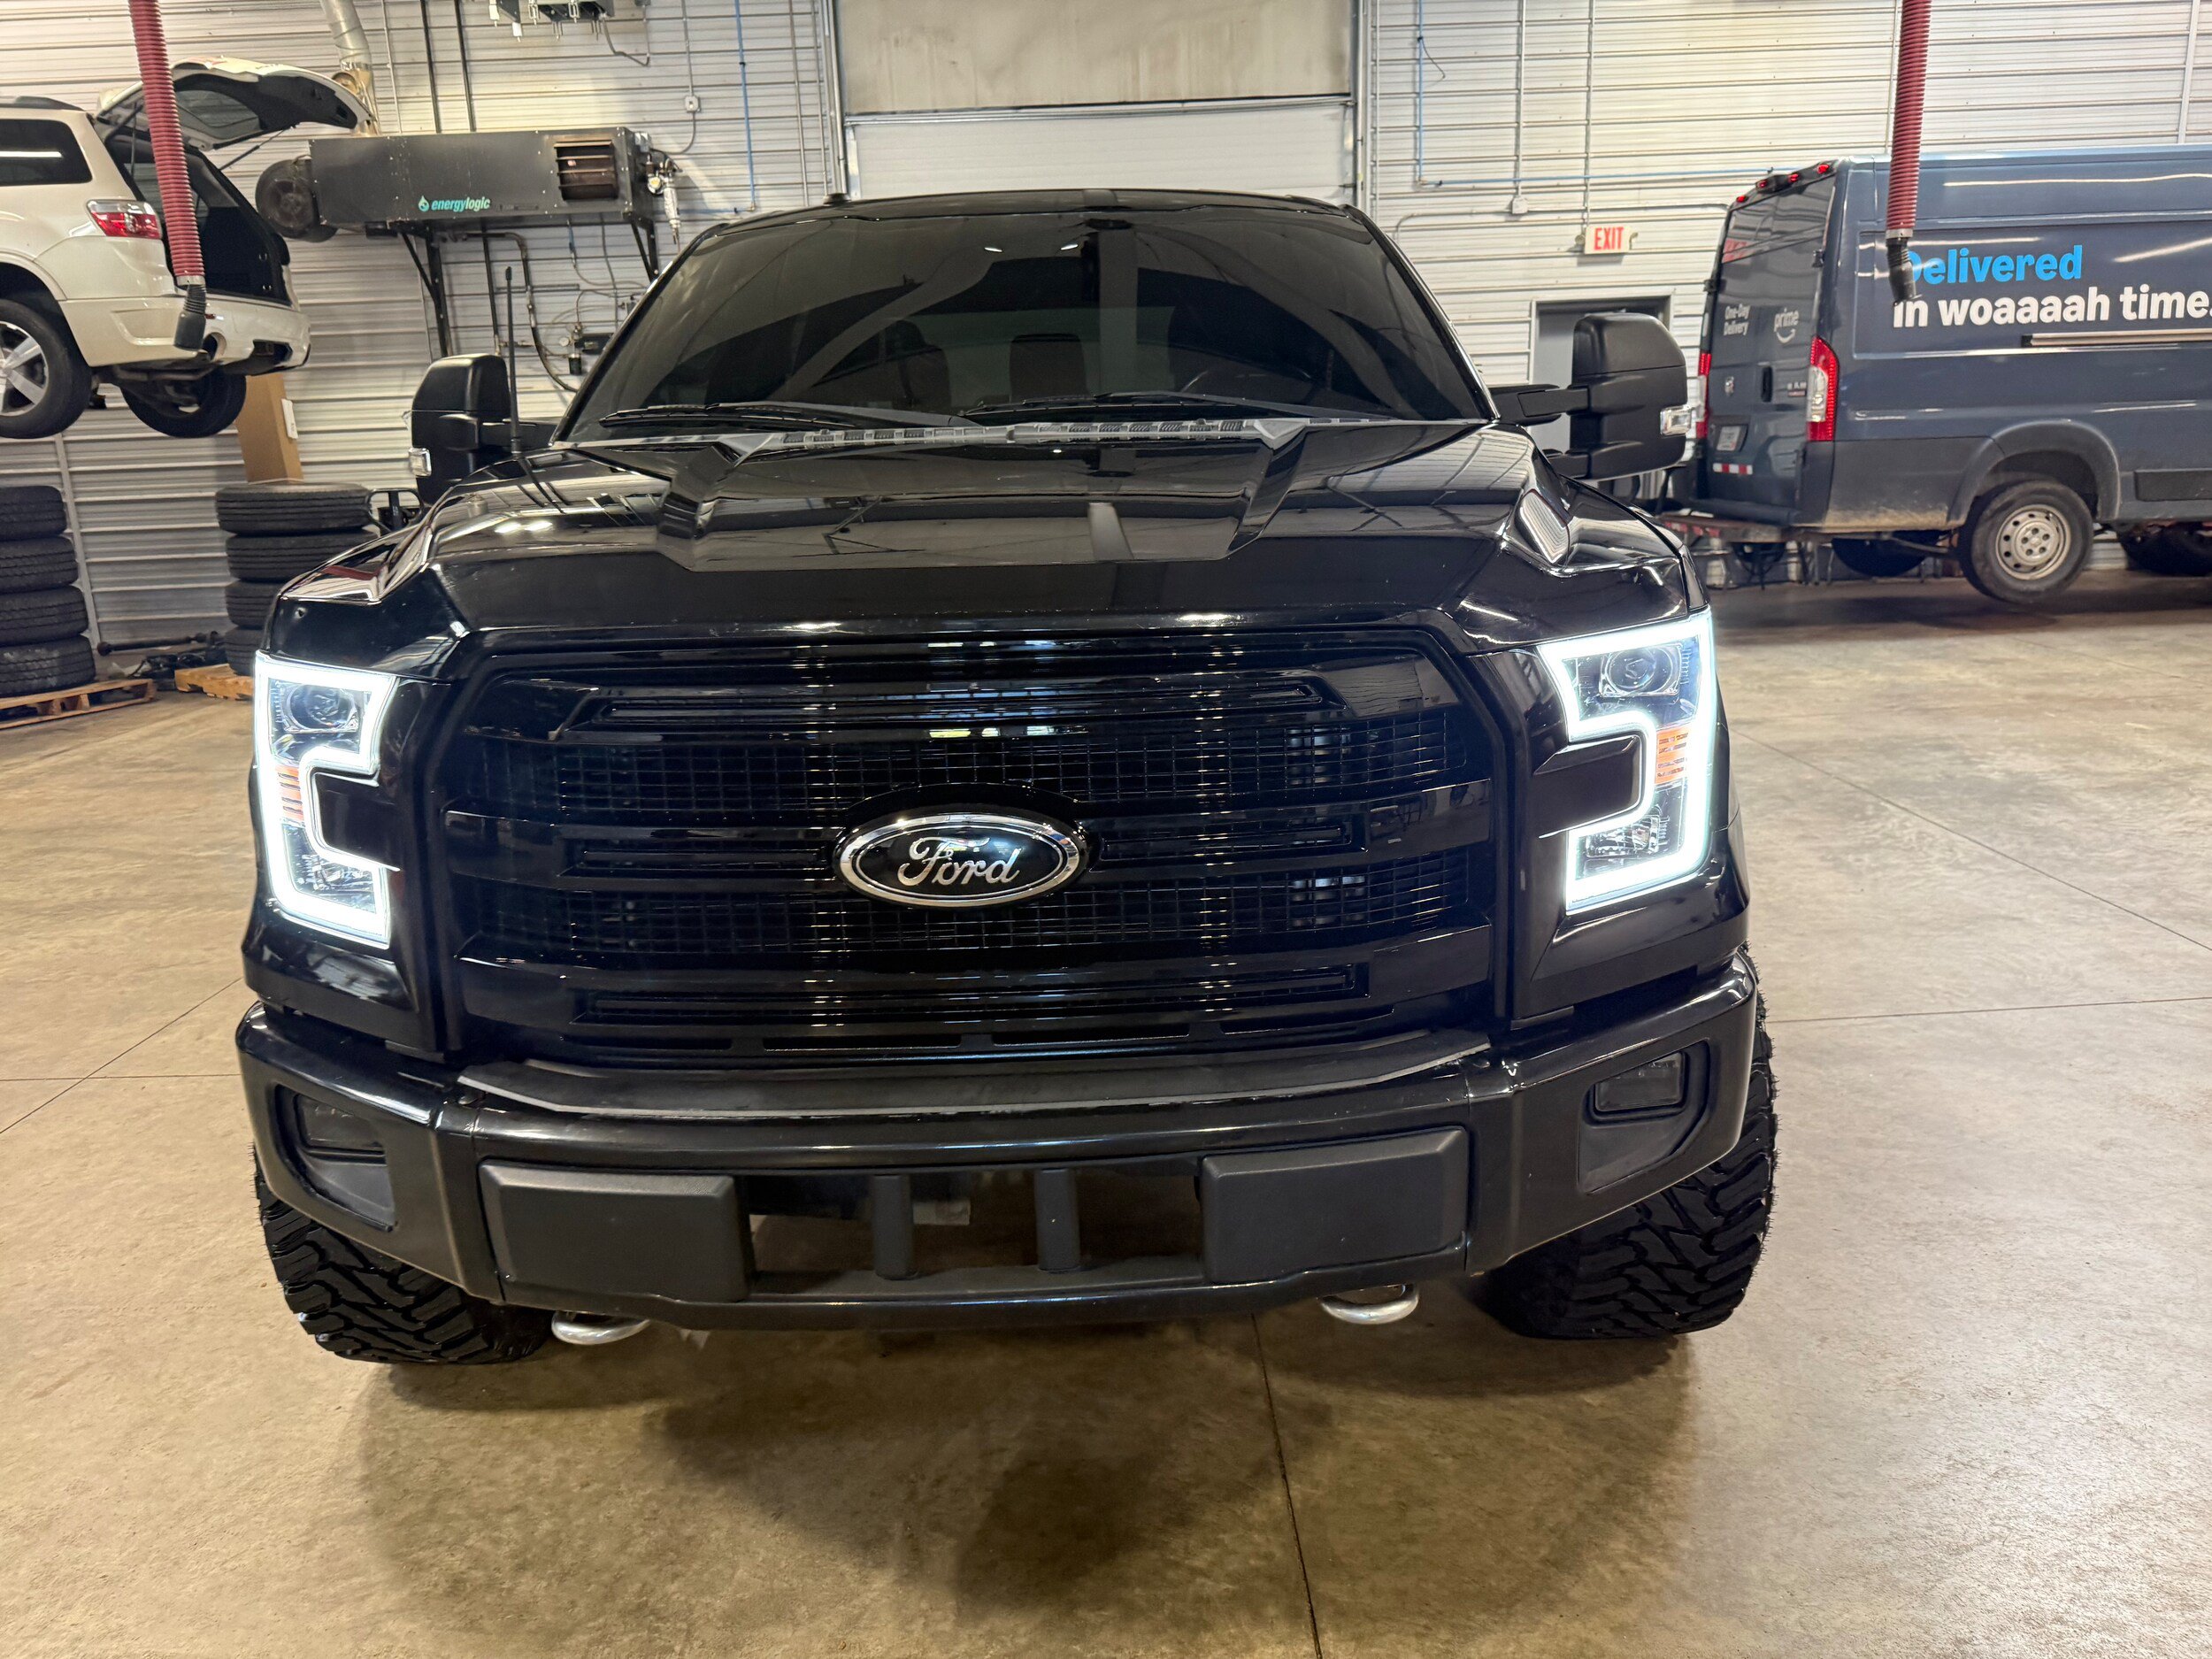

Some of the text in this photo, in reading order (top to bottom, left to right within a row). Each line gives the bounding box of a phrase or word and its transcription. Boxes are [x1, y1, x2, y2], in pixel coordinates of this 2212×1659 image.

[431, 196, 491, 212] energylogic
[1594, 226, 1624, 250] EXIT
[1938, 286, 2110, 326] woaaaah
[1774, 308, 1799, 332] prime
[897, 836, 1022, 886] Ford
